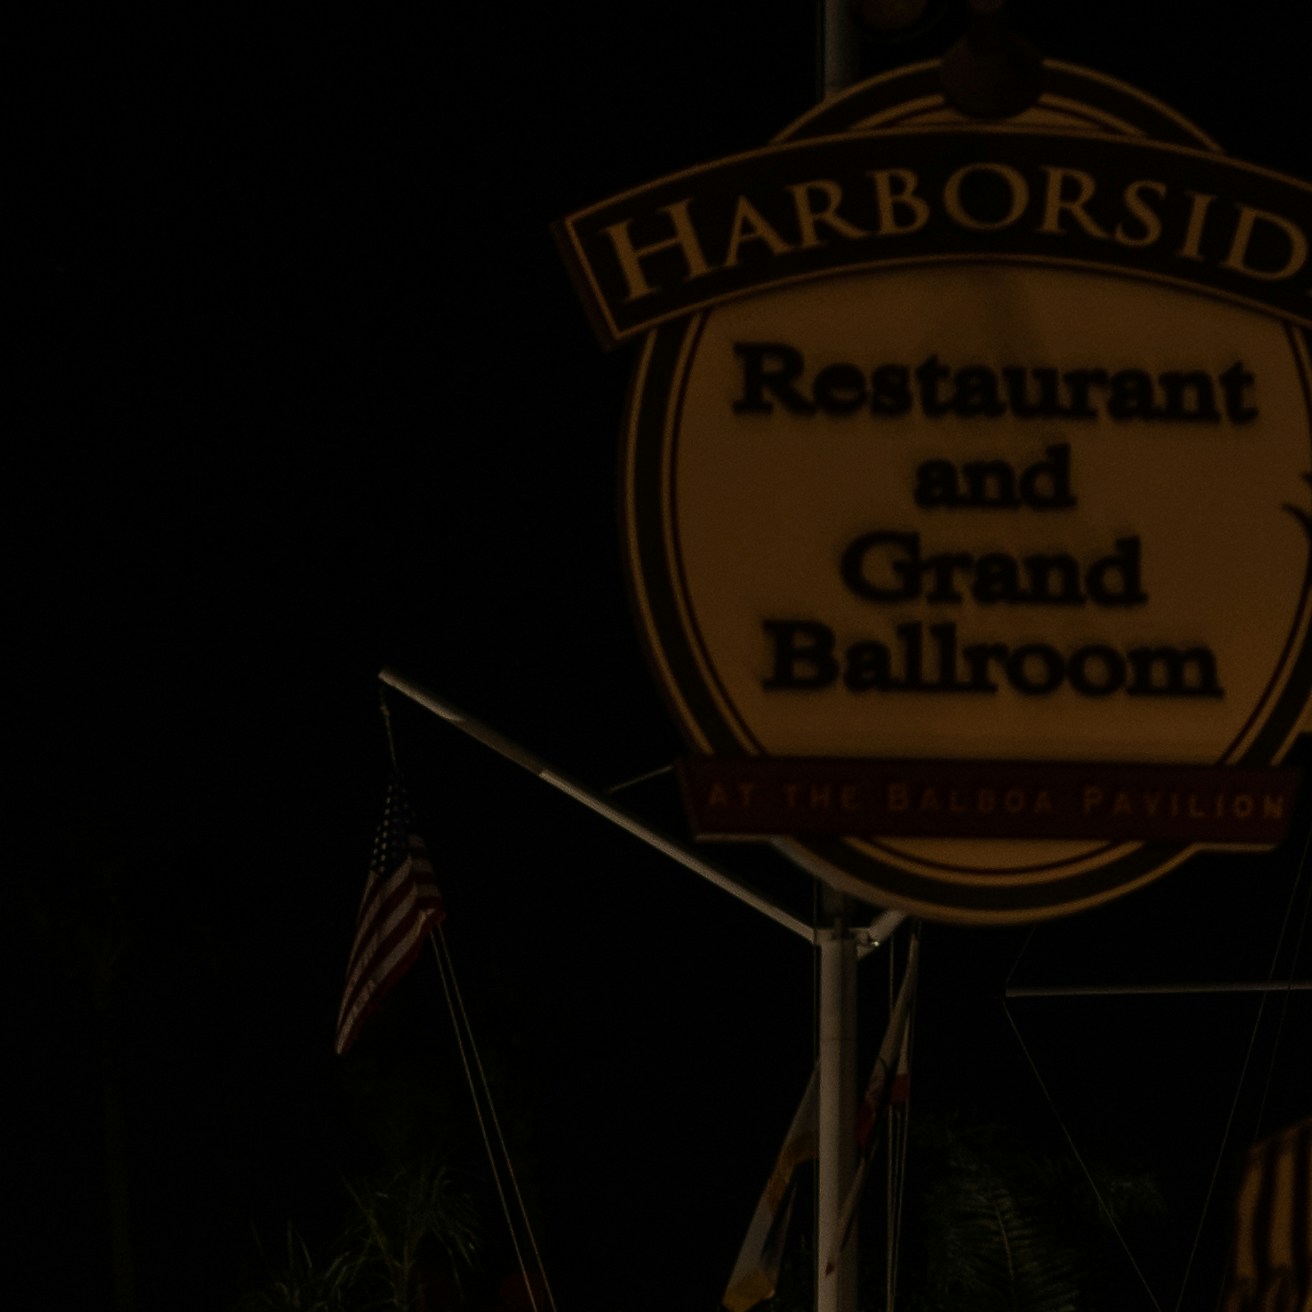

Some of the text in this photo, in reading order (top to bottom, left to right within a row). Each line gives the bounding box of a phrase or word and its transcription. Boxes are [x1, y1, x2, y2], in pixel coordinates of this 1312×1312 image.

[597, 161, 1312, 304] HARBORSID
[732, 341, 1261, 424] Restaurant
[914, 444, 1076, 509] and
[840, 530, 1148, 607] Grand
[761, 620, 1225, 699] Ballroom
[705, 782, 758, 809] AT
[782, 782, 858, 812] THE
[1084, 785, 1286, 822] PAVILION
